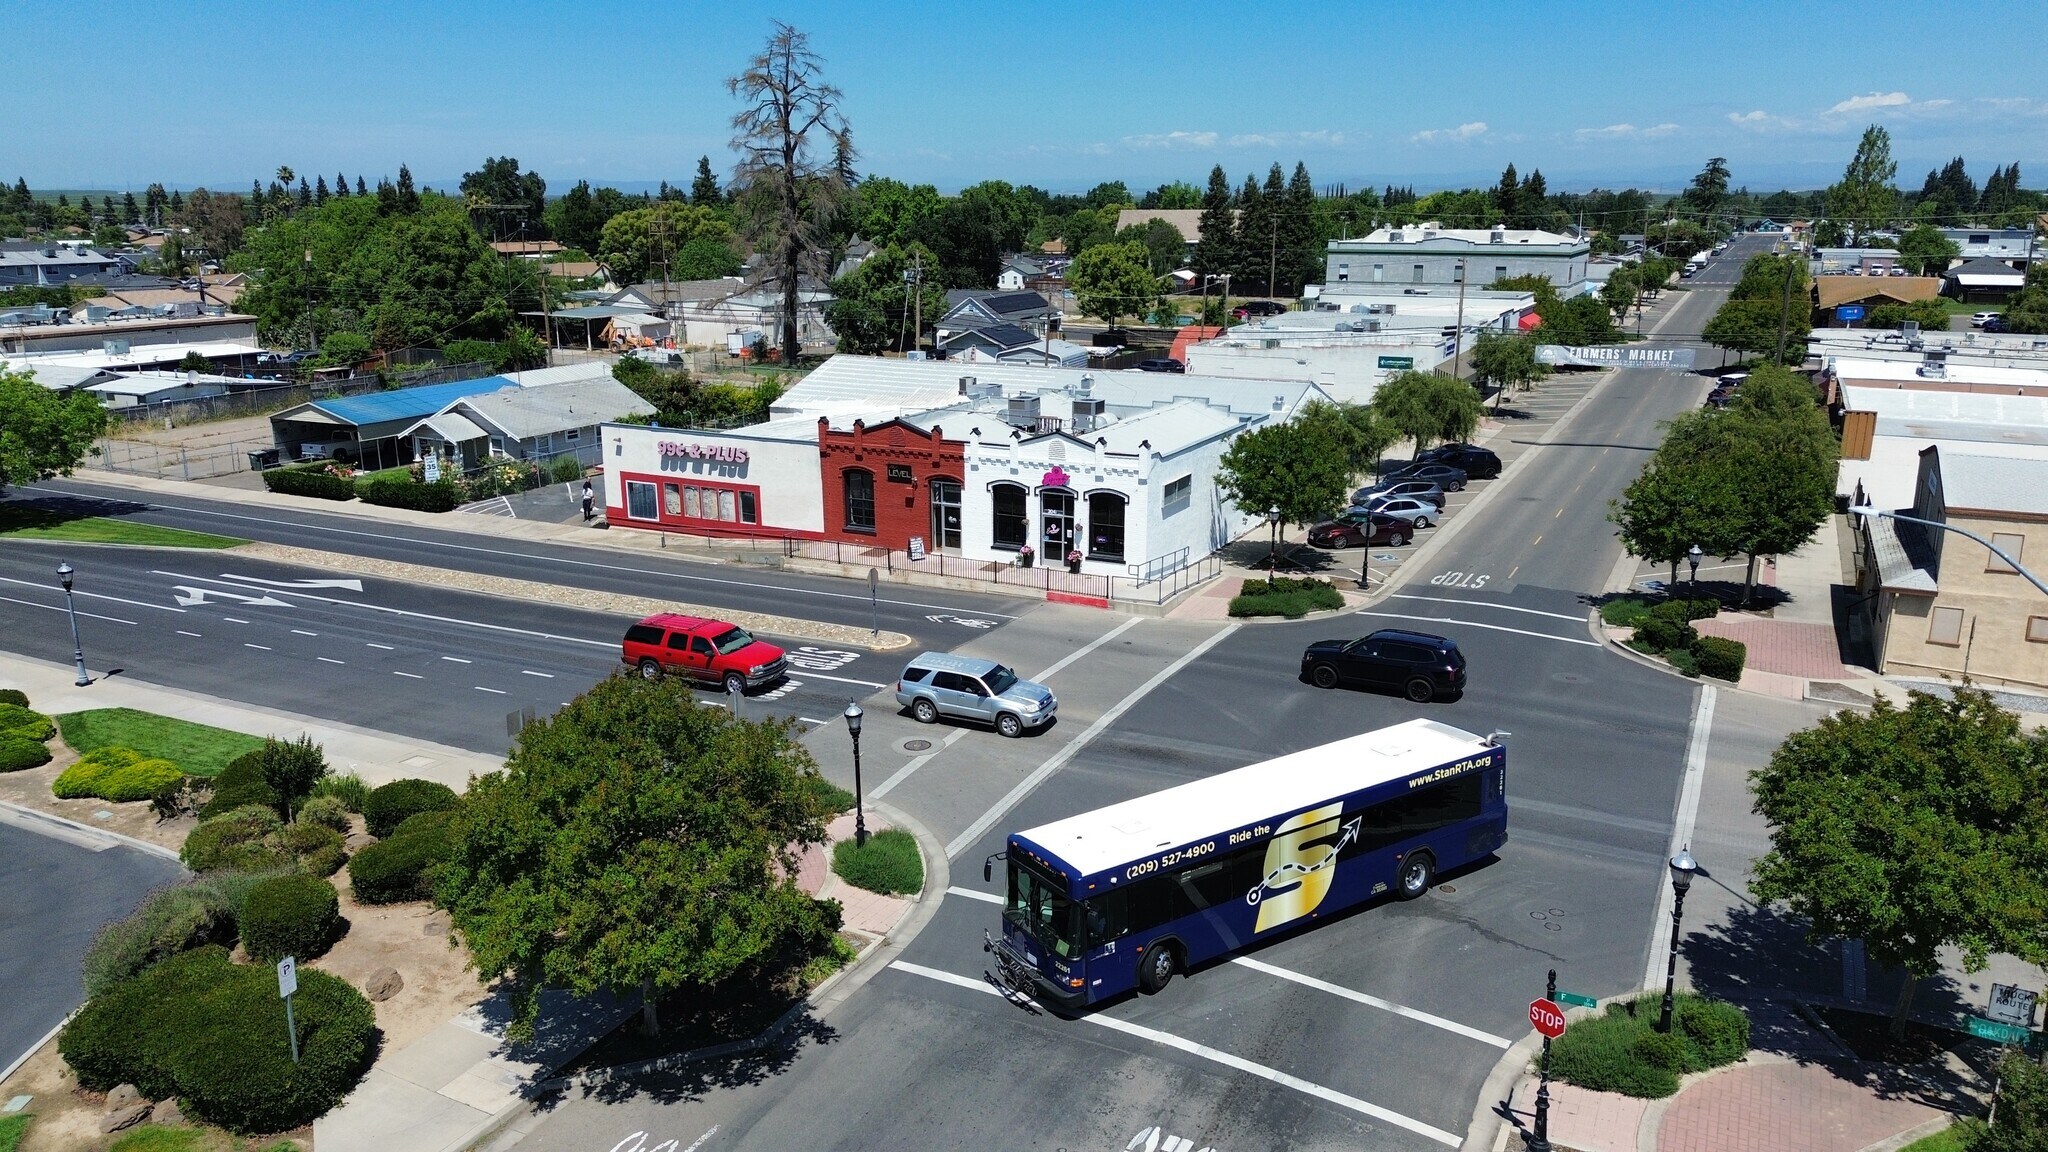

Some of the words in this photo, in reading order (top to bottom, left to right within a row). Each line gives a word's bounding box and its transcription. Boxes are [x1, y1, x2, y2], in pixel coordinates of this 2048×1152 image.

[1569, 348, 1624, 360] FARMERS'
[1628, 349, 1674, 361] MARKET
[657, 441, 686, 458] 99¢
[689, 443, 701, 459] &
[705, 445, 748, 463] PLUS
[888, 469, 911, 479] LEVEL
[1430, 571, 1490, 589] STOP
[1408, 755, 1491, 789] www.StanRTA.org
[1229, 829, 1251, 845] Ride
[1253, 824, 1270, 837] the
[1126, 859, 1158, 880] (209)
[1161, 841, 1215, 867] 527-4900
[1996, 996, 2029, 1011] ROUTE
[1998, 988, 2031, 1002] TRUCK
[1531, 1006, 1563, 1029] STOP
